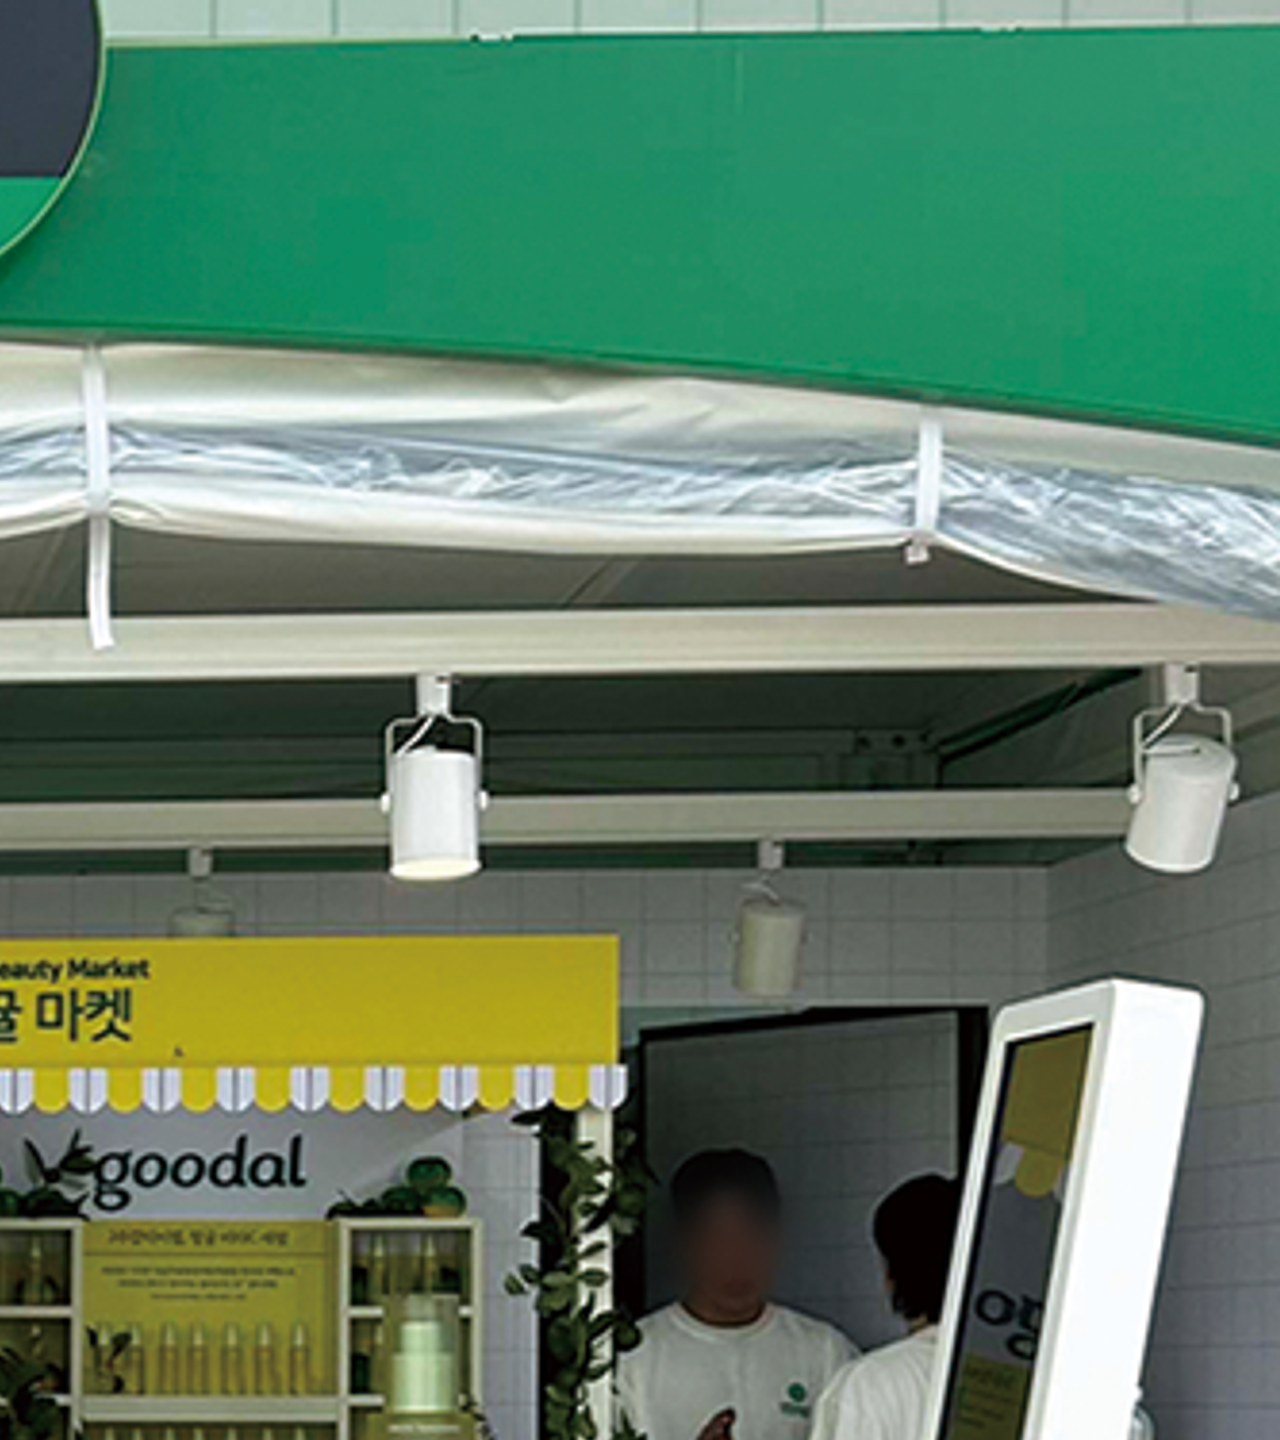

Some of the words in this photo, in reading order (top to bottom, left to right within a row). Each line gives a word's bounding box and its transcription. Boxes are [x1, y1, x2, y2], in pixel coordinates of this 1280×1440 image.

[67, 957, 150, 980] Market
[36, 988, 133, 1043] 마켓
[92, 1133, 307, 1212] goodal
